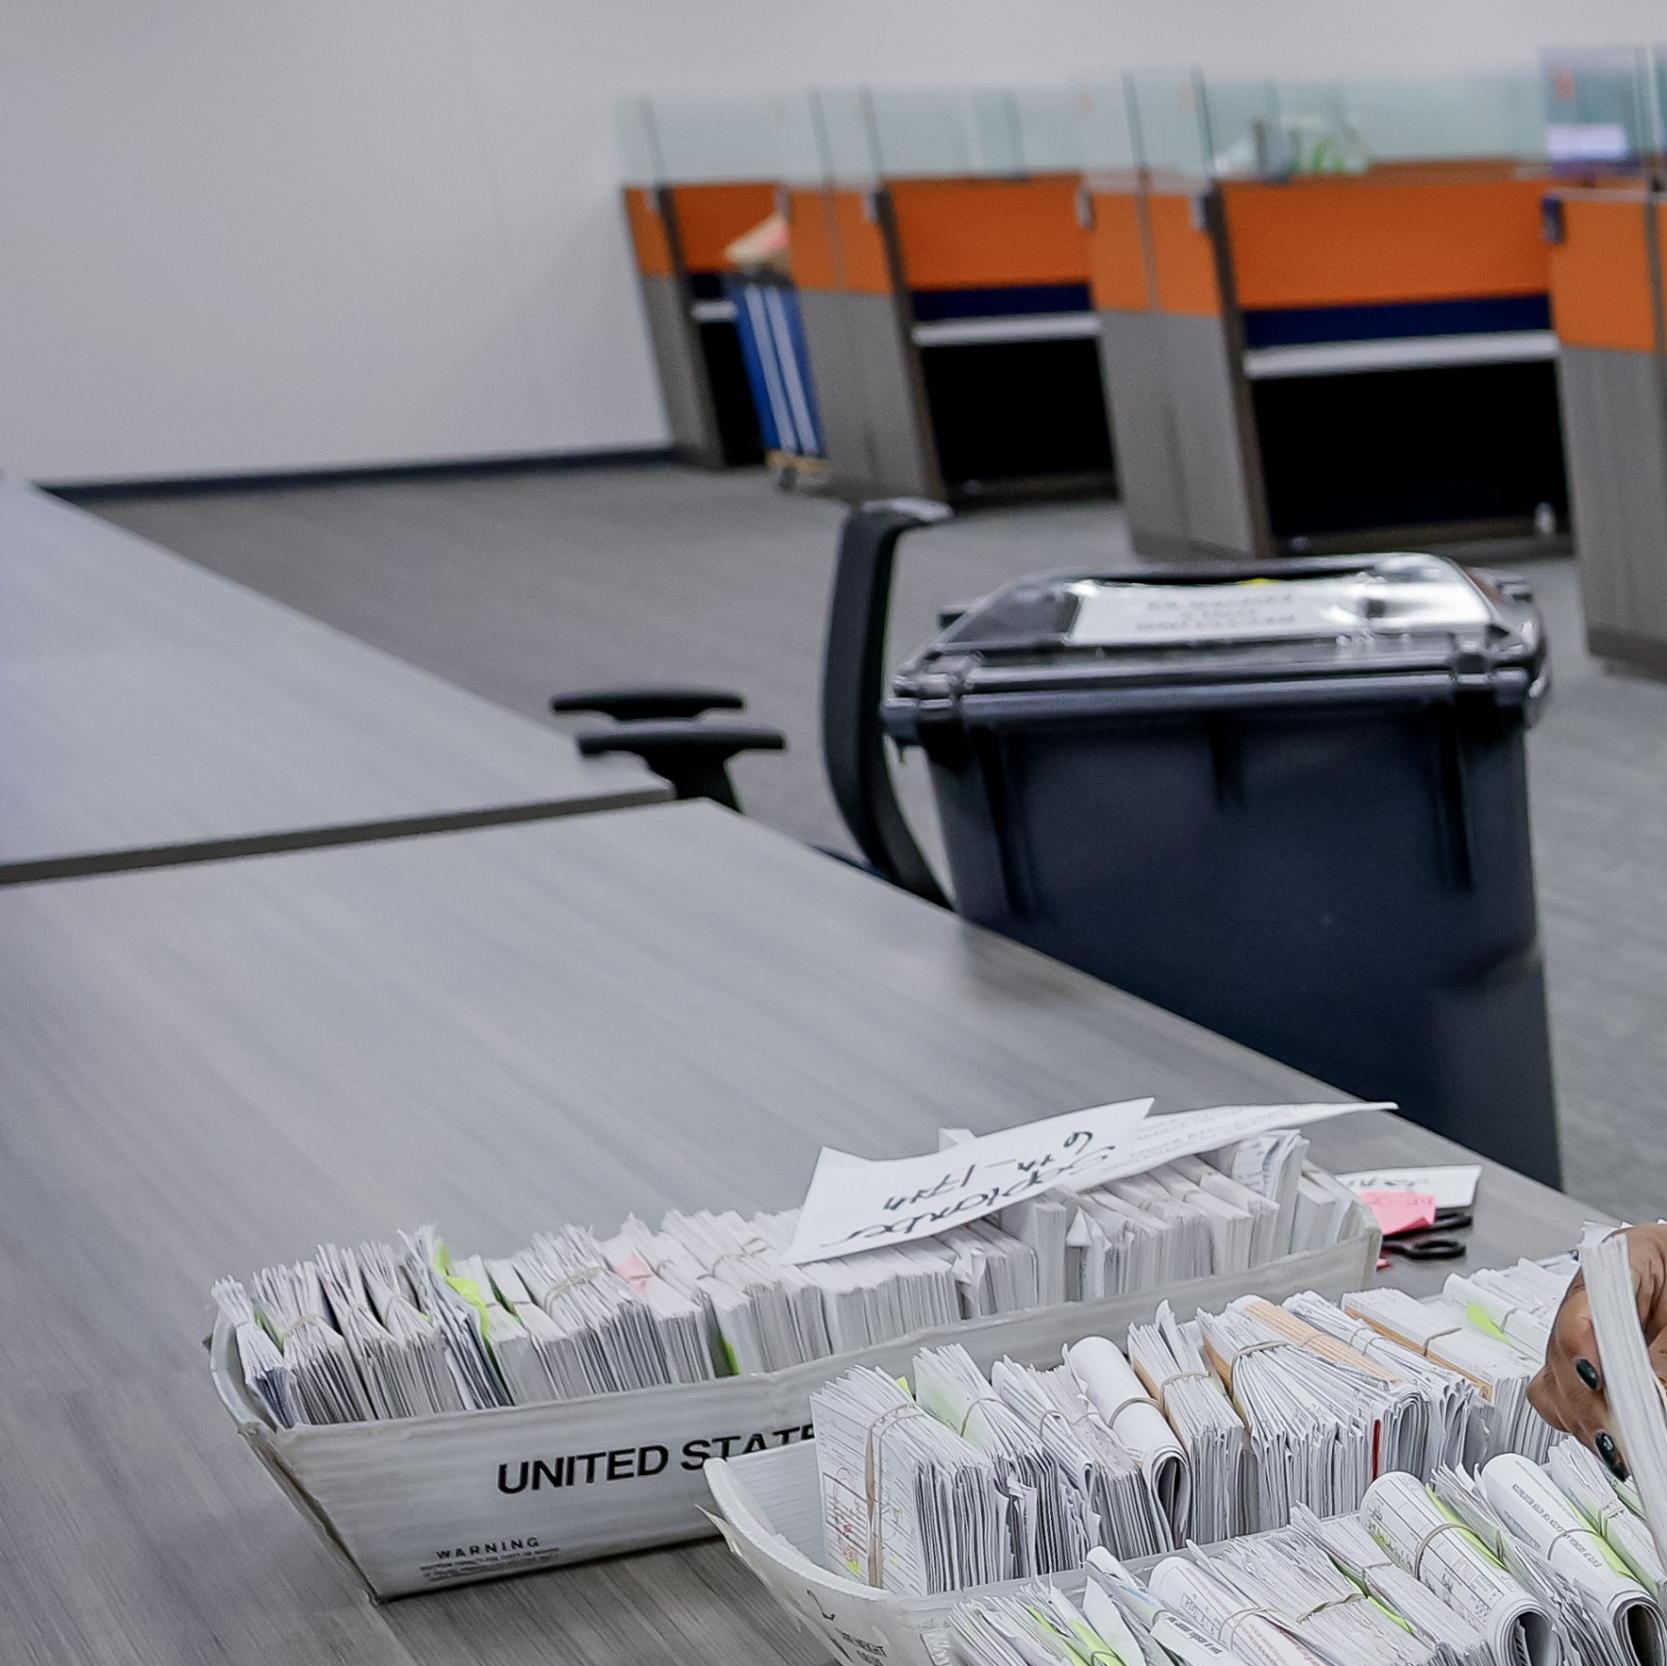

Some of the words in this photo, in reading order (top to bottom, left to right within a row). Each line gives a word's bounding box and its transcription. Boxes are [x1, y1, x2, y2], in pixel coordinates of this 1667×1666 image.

[497, 1445, 669, 1494] UNITED
[681, 1423, 815, 1470] STAT
[436, 1537, 540, 1560] WARNING
